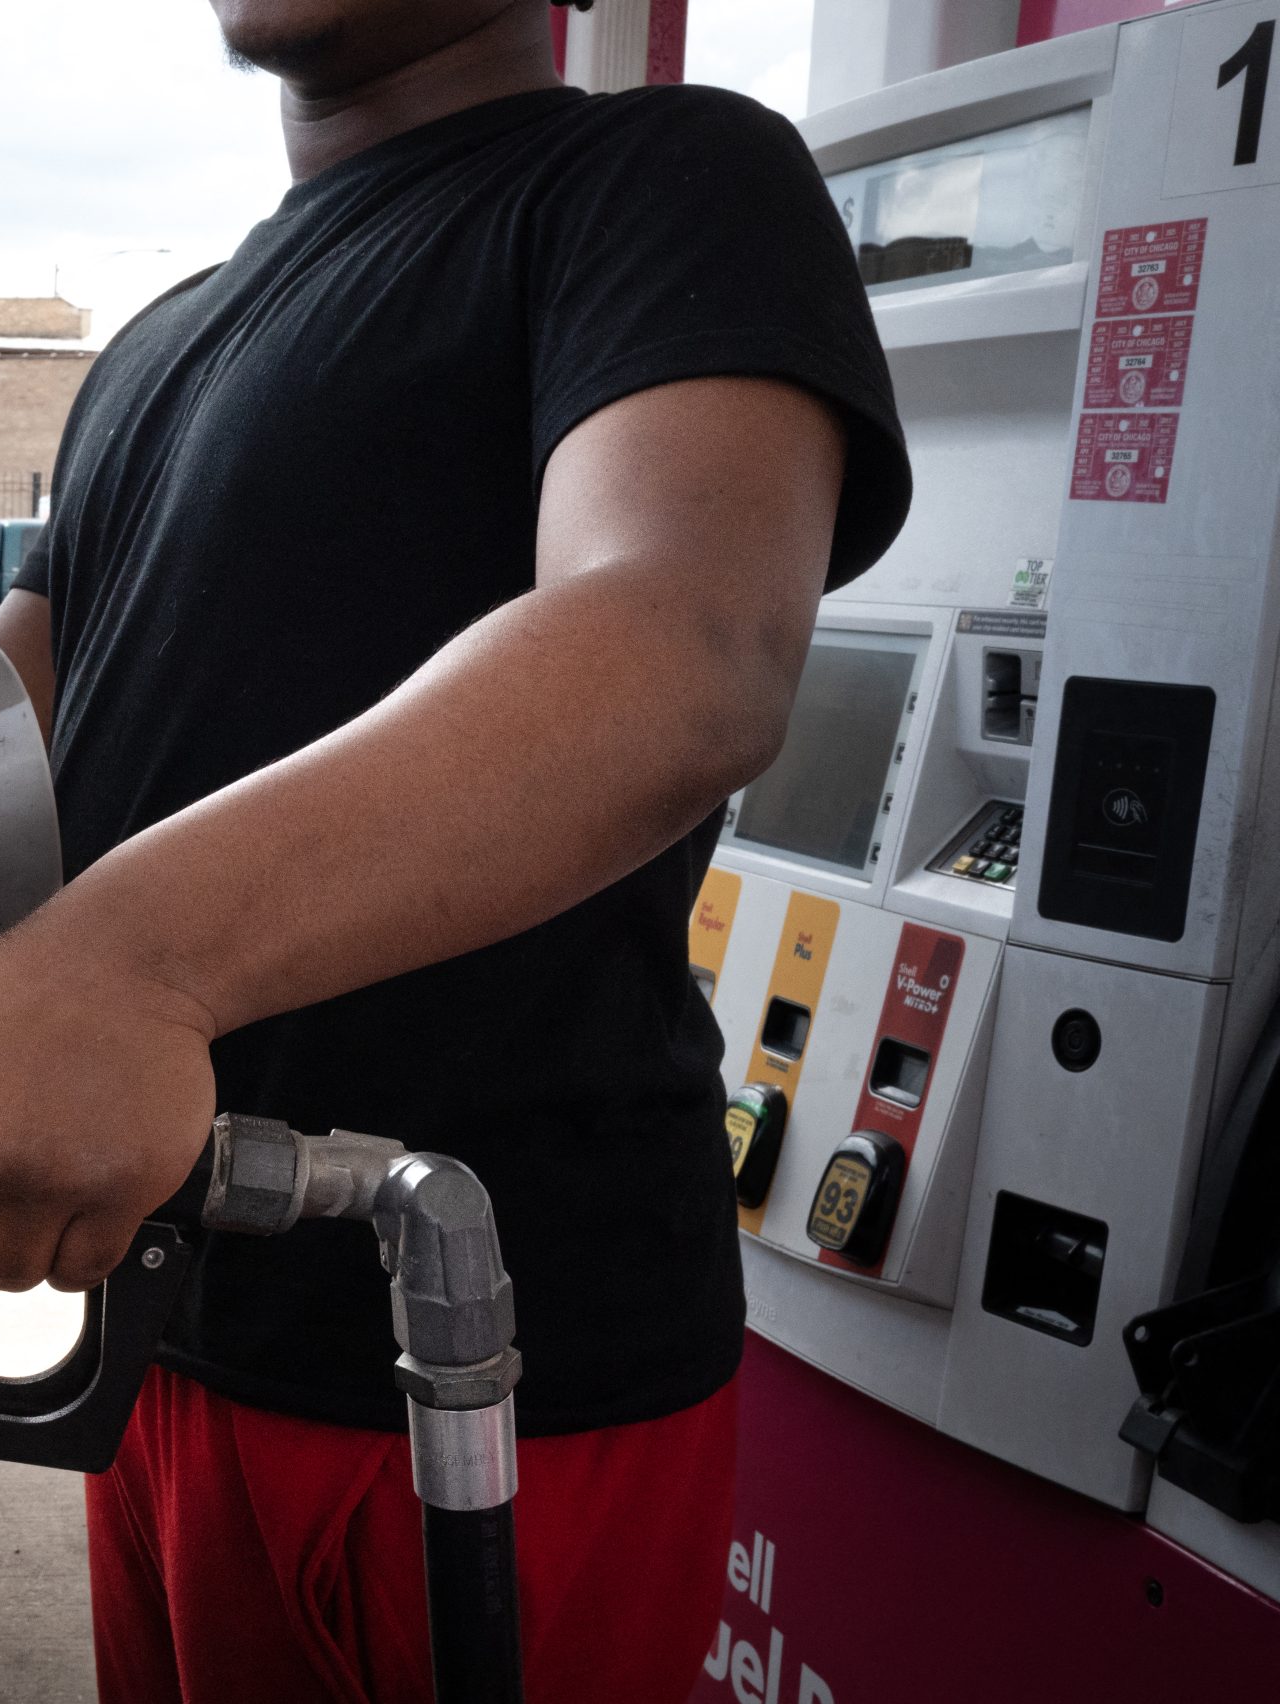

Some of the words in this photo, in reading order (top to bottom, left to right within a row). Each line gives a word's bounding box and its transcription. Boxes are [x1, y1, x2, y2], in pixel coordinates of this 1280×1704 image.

[1216, 20, 1276, 166] 1
[1124, 248, 1138, 256] CITY
[1140, 246, 1148, 254] OF
[1149, 241, 1179, 252] CHICAGO
[1127, 339, 1135, 347] OF
[1136, 337, 1165, 346] CHICAGO
[1098, 433, 1112, 441] CITY
[1113, 433, 1121, 441] OF
[1123, 433, 1151, 441] CHICAGO
[1027, 560, 1044, 572] TOP
[1029, 572, 1049, 584] TIER
[794, 943, 812, 960] Plus
[899, 962, 918, 977] Shell
[897, 974, 943, 1002] V-Power
[820, 1181, 859, 1224] 93
[727, 1529, 776, 1615] ell
[704, 1619, 785, 1704] uel
